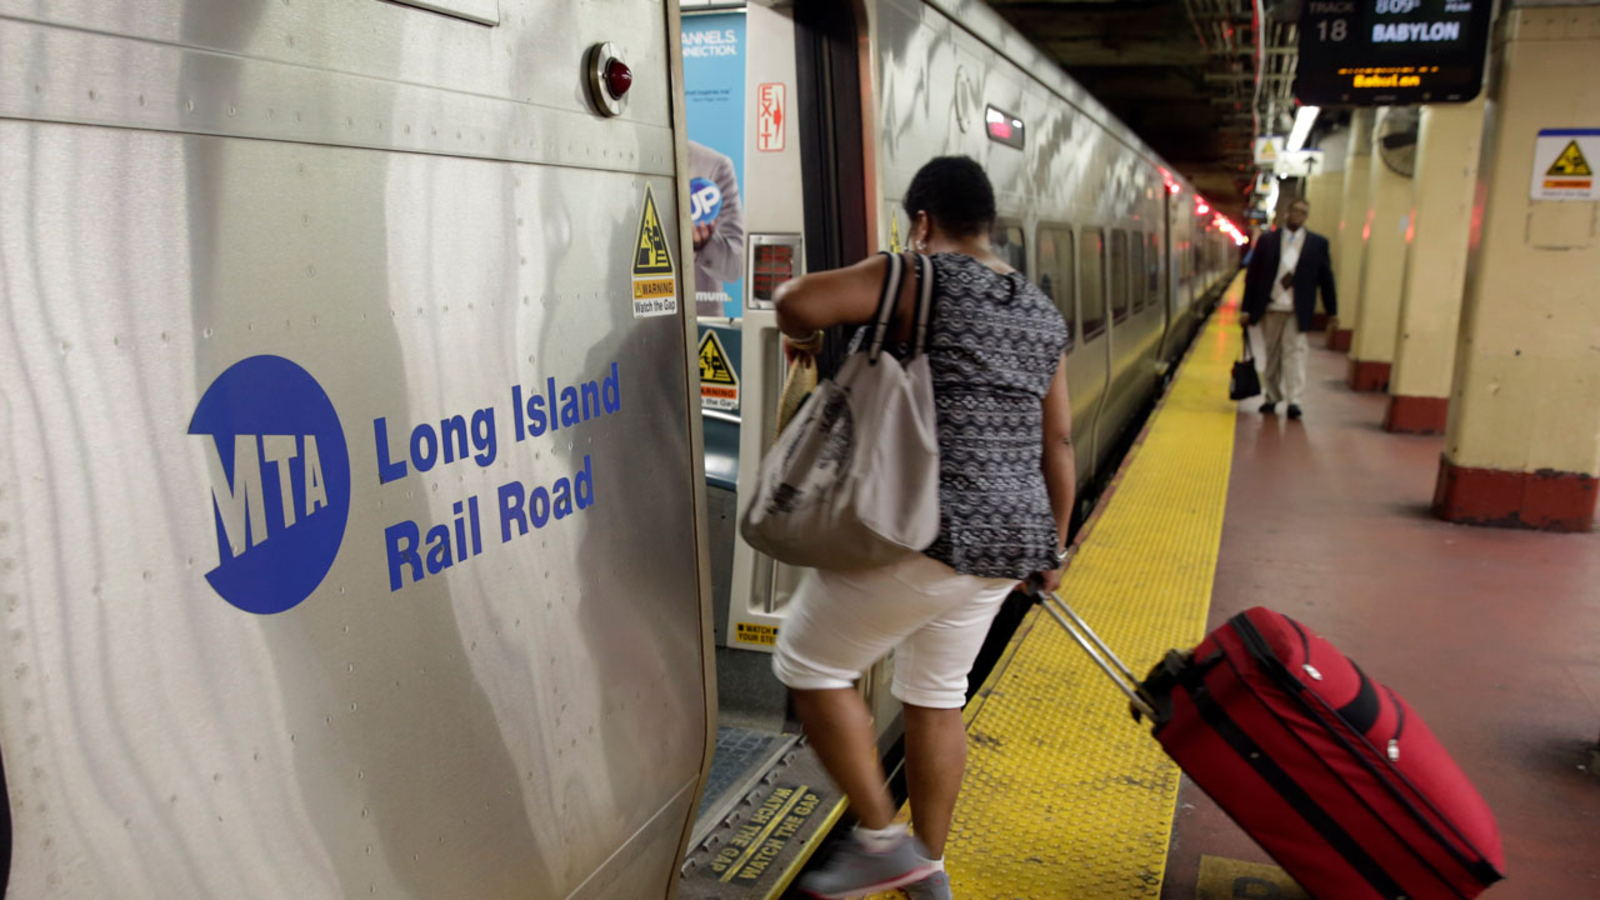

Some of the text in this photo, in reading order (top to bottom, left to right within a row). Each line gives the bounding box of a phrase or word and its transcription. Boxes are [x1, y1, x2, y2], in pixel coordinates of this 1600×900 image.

[1316, 19, 1348, 42] 18
[1372, 21, 1460, 43] BABYLON
[760, 86, 772, 150] EXIT
[635, 298, 676, 314] Watch the Gap
[642, 281, 674, 295] WARNING
[373, 362, 622, 485] Long Island
[188, 434, 329, 568] MTA
[384, 454, 595, 593] Rail Road
[746, 625, 771, 635] WATCH
[710, 787, 794, 872] WATCH THE GAP
[738, 793, 821, 880] WATCH THE GAP
